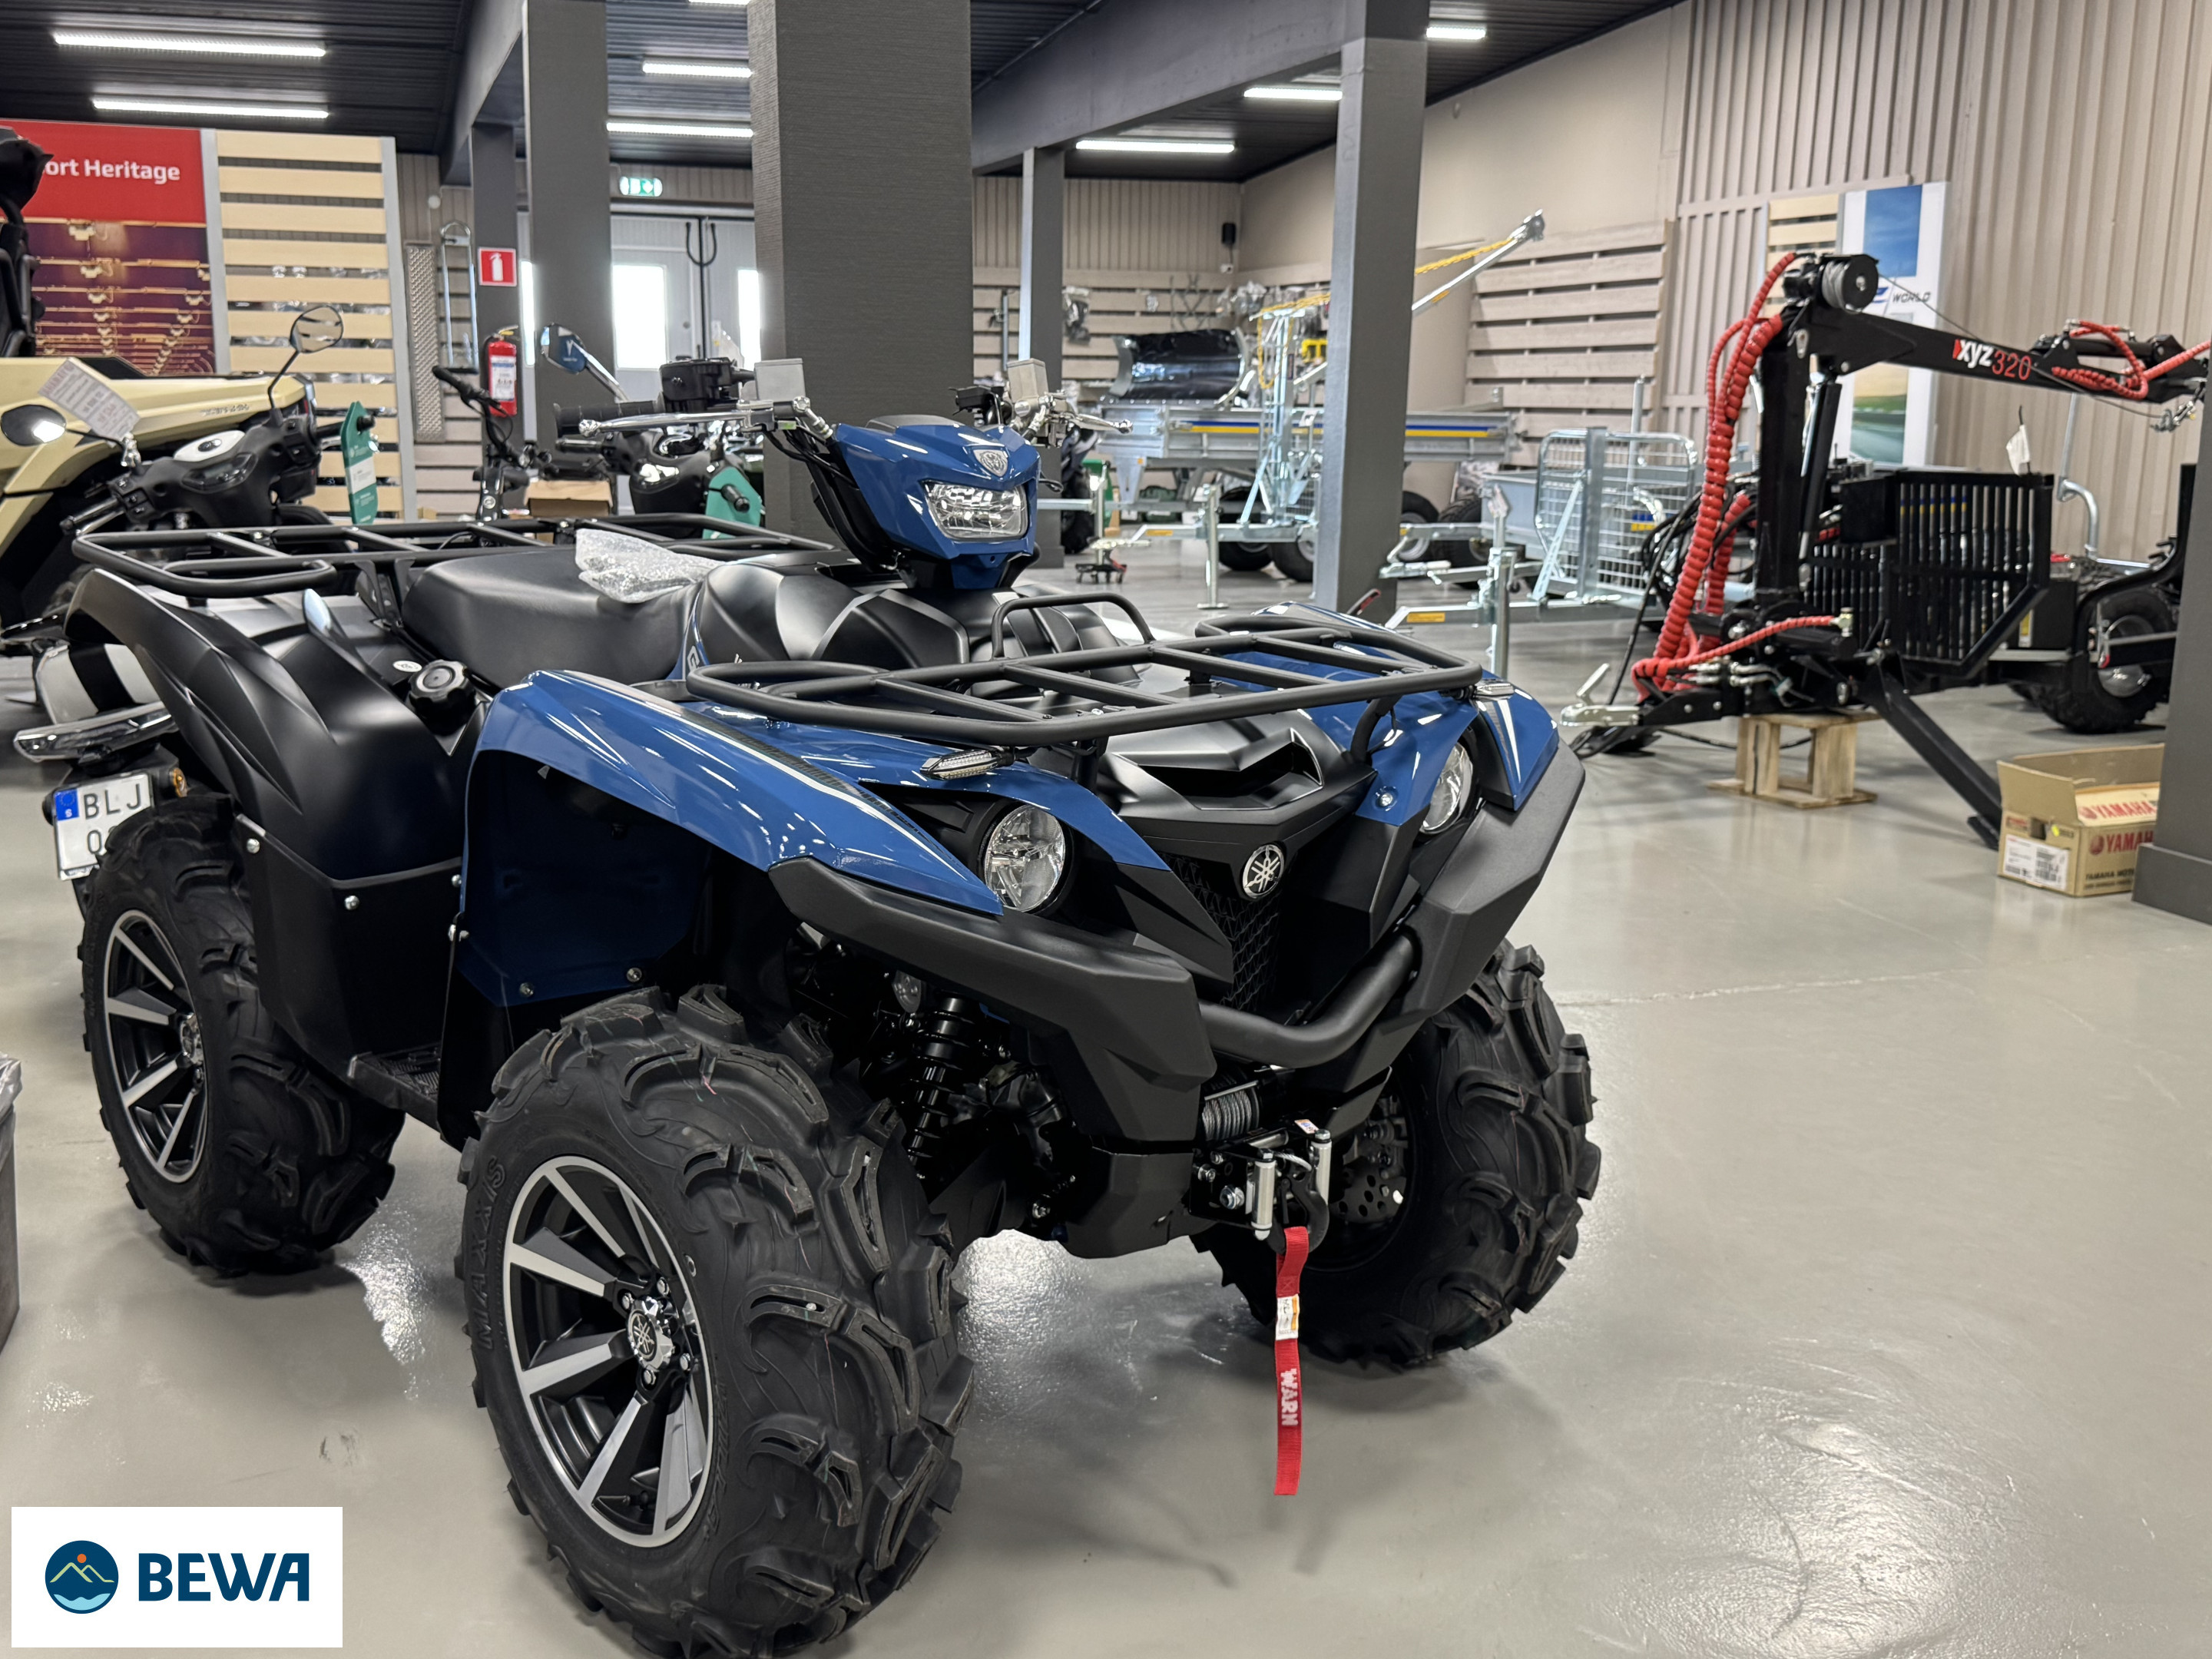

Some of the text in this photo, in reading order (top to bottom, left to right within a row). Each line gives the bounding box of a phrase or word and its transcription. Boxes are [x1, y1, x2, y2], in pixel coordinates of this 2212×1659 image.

[44, 158, 180, 184] ort Heritage
[1956, 339, 2032, 381] xyz 320
[65, 808, 73, 818] S
[84, 783, 141, 820] BLJ
[2095, 800, 2157, 819] YAMAHA
[2106, 830, 2154, 853] YAMAH
[470, 1154, 506, 1350] MAXXIS
[1280, 1368, 1299, 1426] WARN
